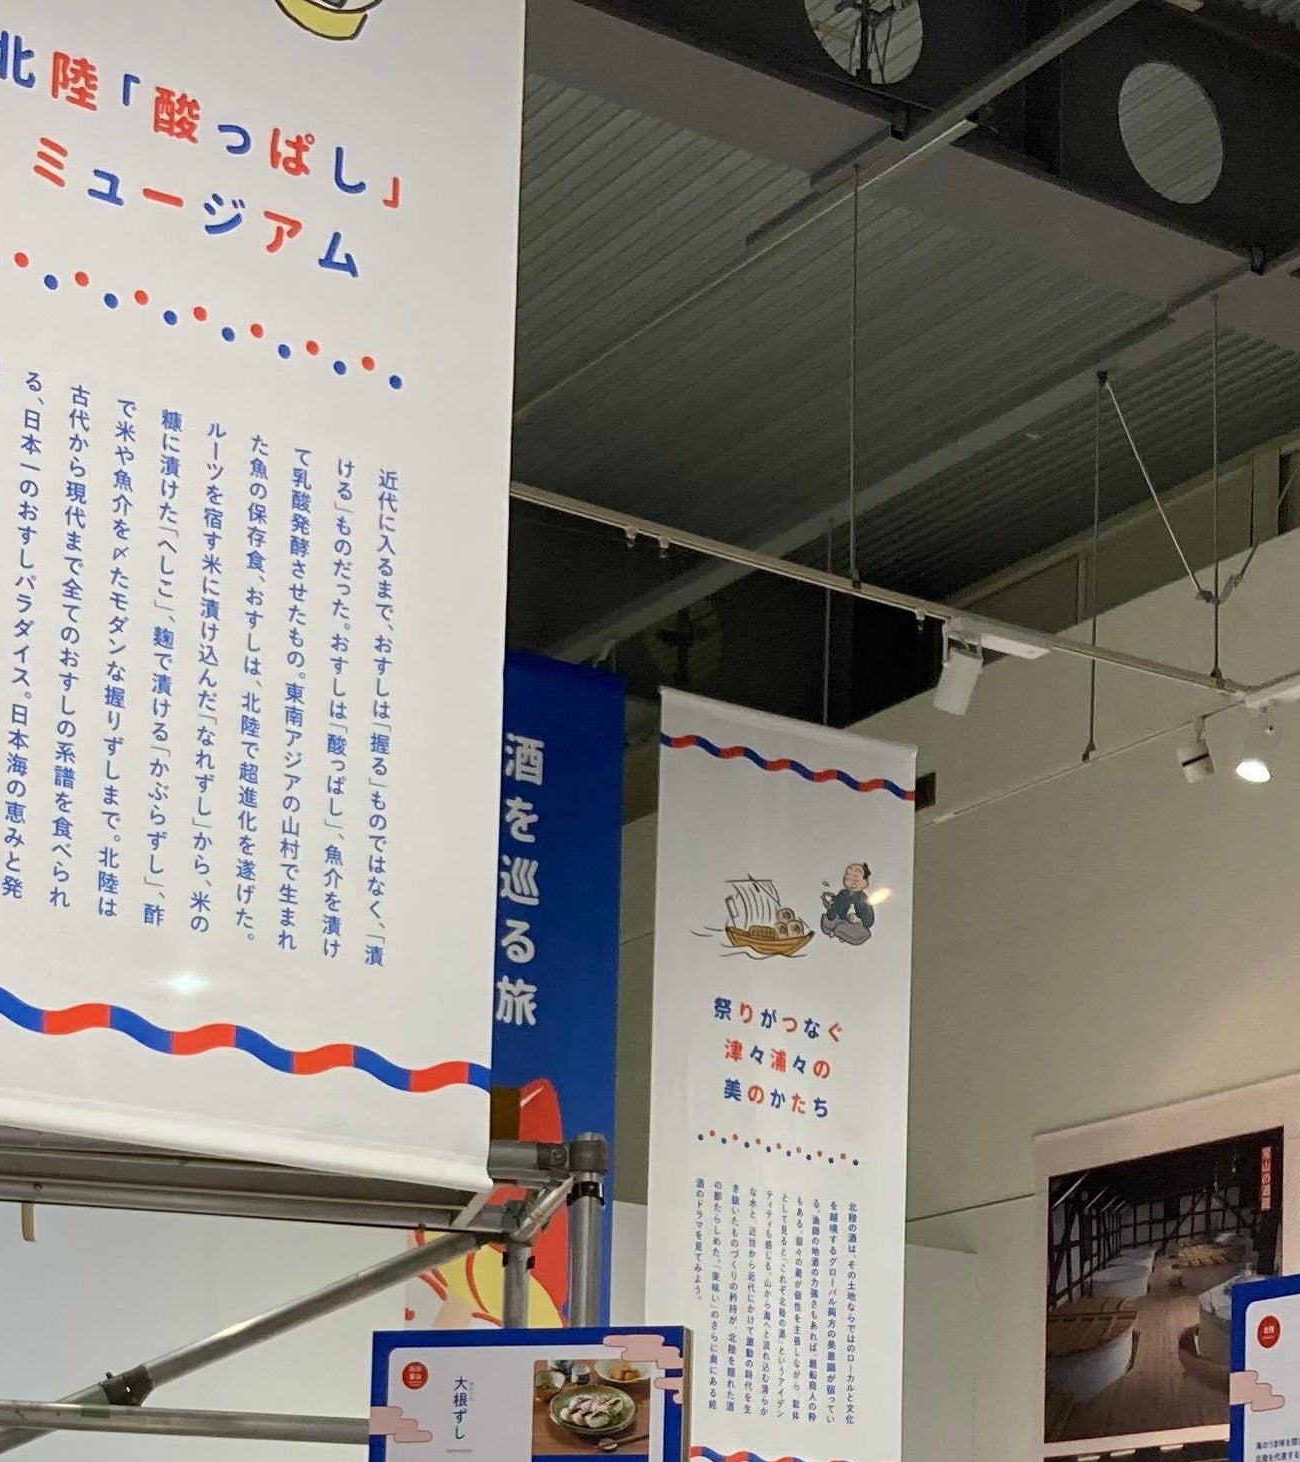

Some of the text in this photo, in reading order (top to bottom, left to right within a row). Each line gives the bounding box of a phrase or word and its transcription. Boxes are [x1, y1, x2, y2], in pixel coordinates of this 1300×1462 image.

[32, 136, 360, 279] ミュージアム
[1, 370, 44, 899] る、日本一のおすしパラダイス。日本海の恵みと発
[49, 384, 91, 908] 古代から現代まで全てのおすしの系譜を食べられ
[277, 447, 313, 951] て乳酸発酵させたもの。東南アジアの山村で生まれ
[495, 732, 545, 1027] 酒を巡る旅
[713, 996, 844, 1043] 祭りがつなぐ
[724, 1037, 831, 1080] 津々浦々の
[723, 1077, 829, 1118] 美のかたち
[452, 1376, 468, 1440] 大根ずし
